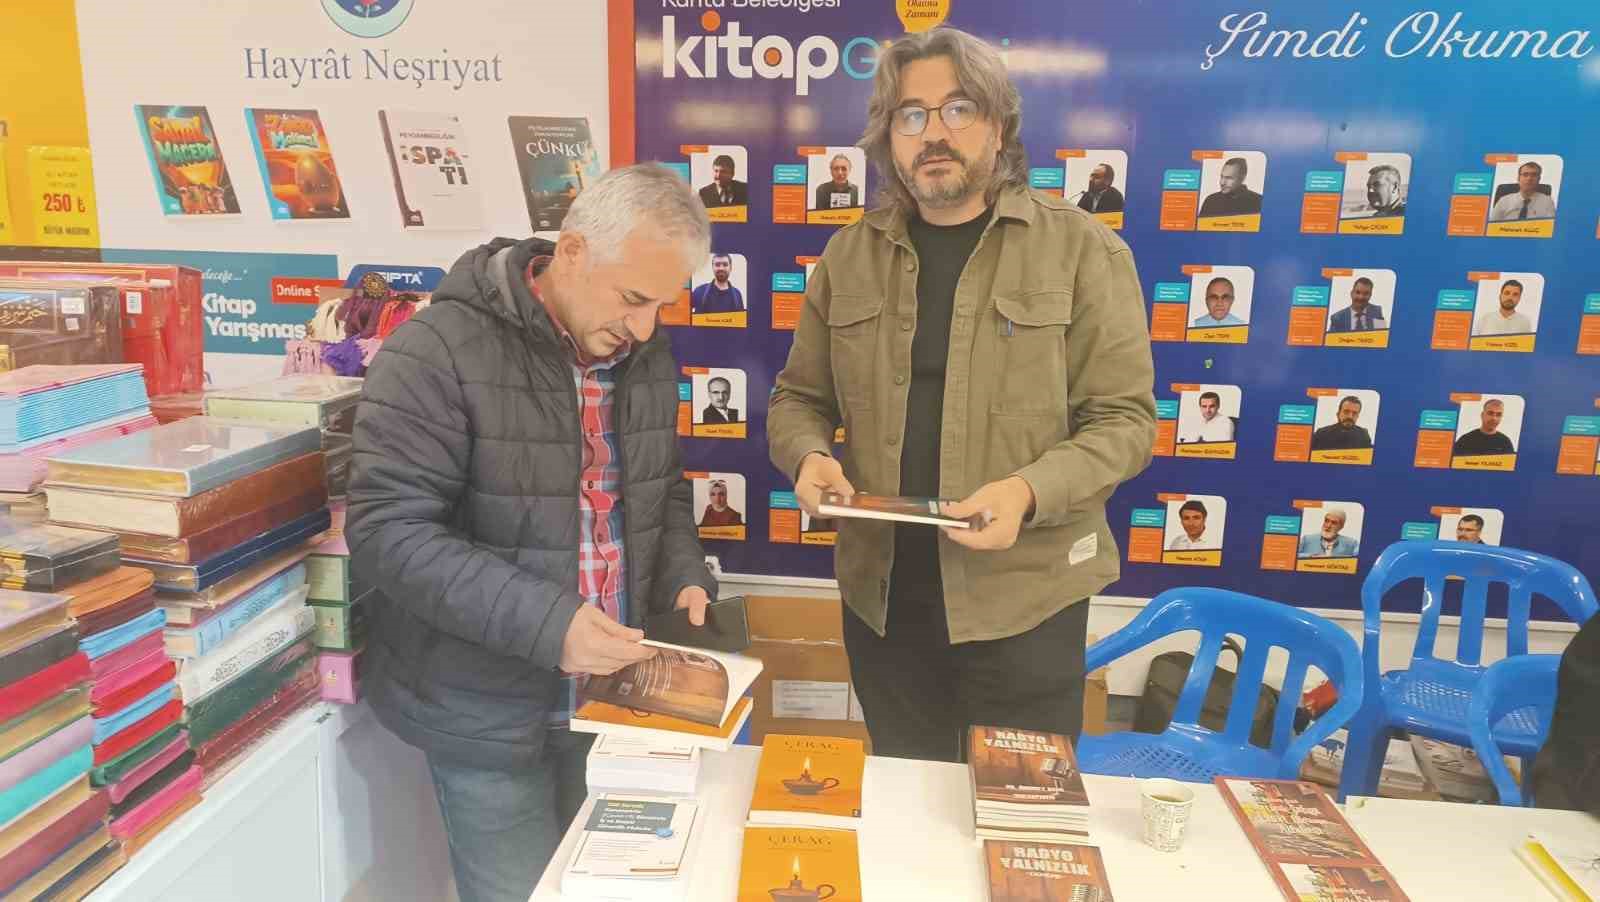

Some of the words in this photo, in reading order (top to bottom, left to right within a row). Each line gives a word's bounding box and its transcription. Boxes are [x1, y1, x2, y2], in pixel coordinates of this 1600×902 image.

[1200, 11, 1368, 70] Şimdi
[1384, 11, 1594, 59] Okuma
[244, 47, 353, 88] Hayrât
[361, 47, 503, 91] Neşriyat
[43, 192, 72, 212] 250
[276, 284, 312, 297] Online
[205, 316, 306, 342] Yarışmas
[984, 738, 1059, 753] YALNIZLIK
[994, 730, 1047, 745] RADYO
[1012, 846, 1075, 862] RADYO
[999, 857, 1090, 877] YALNIZLIK
